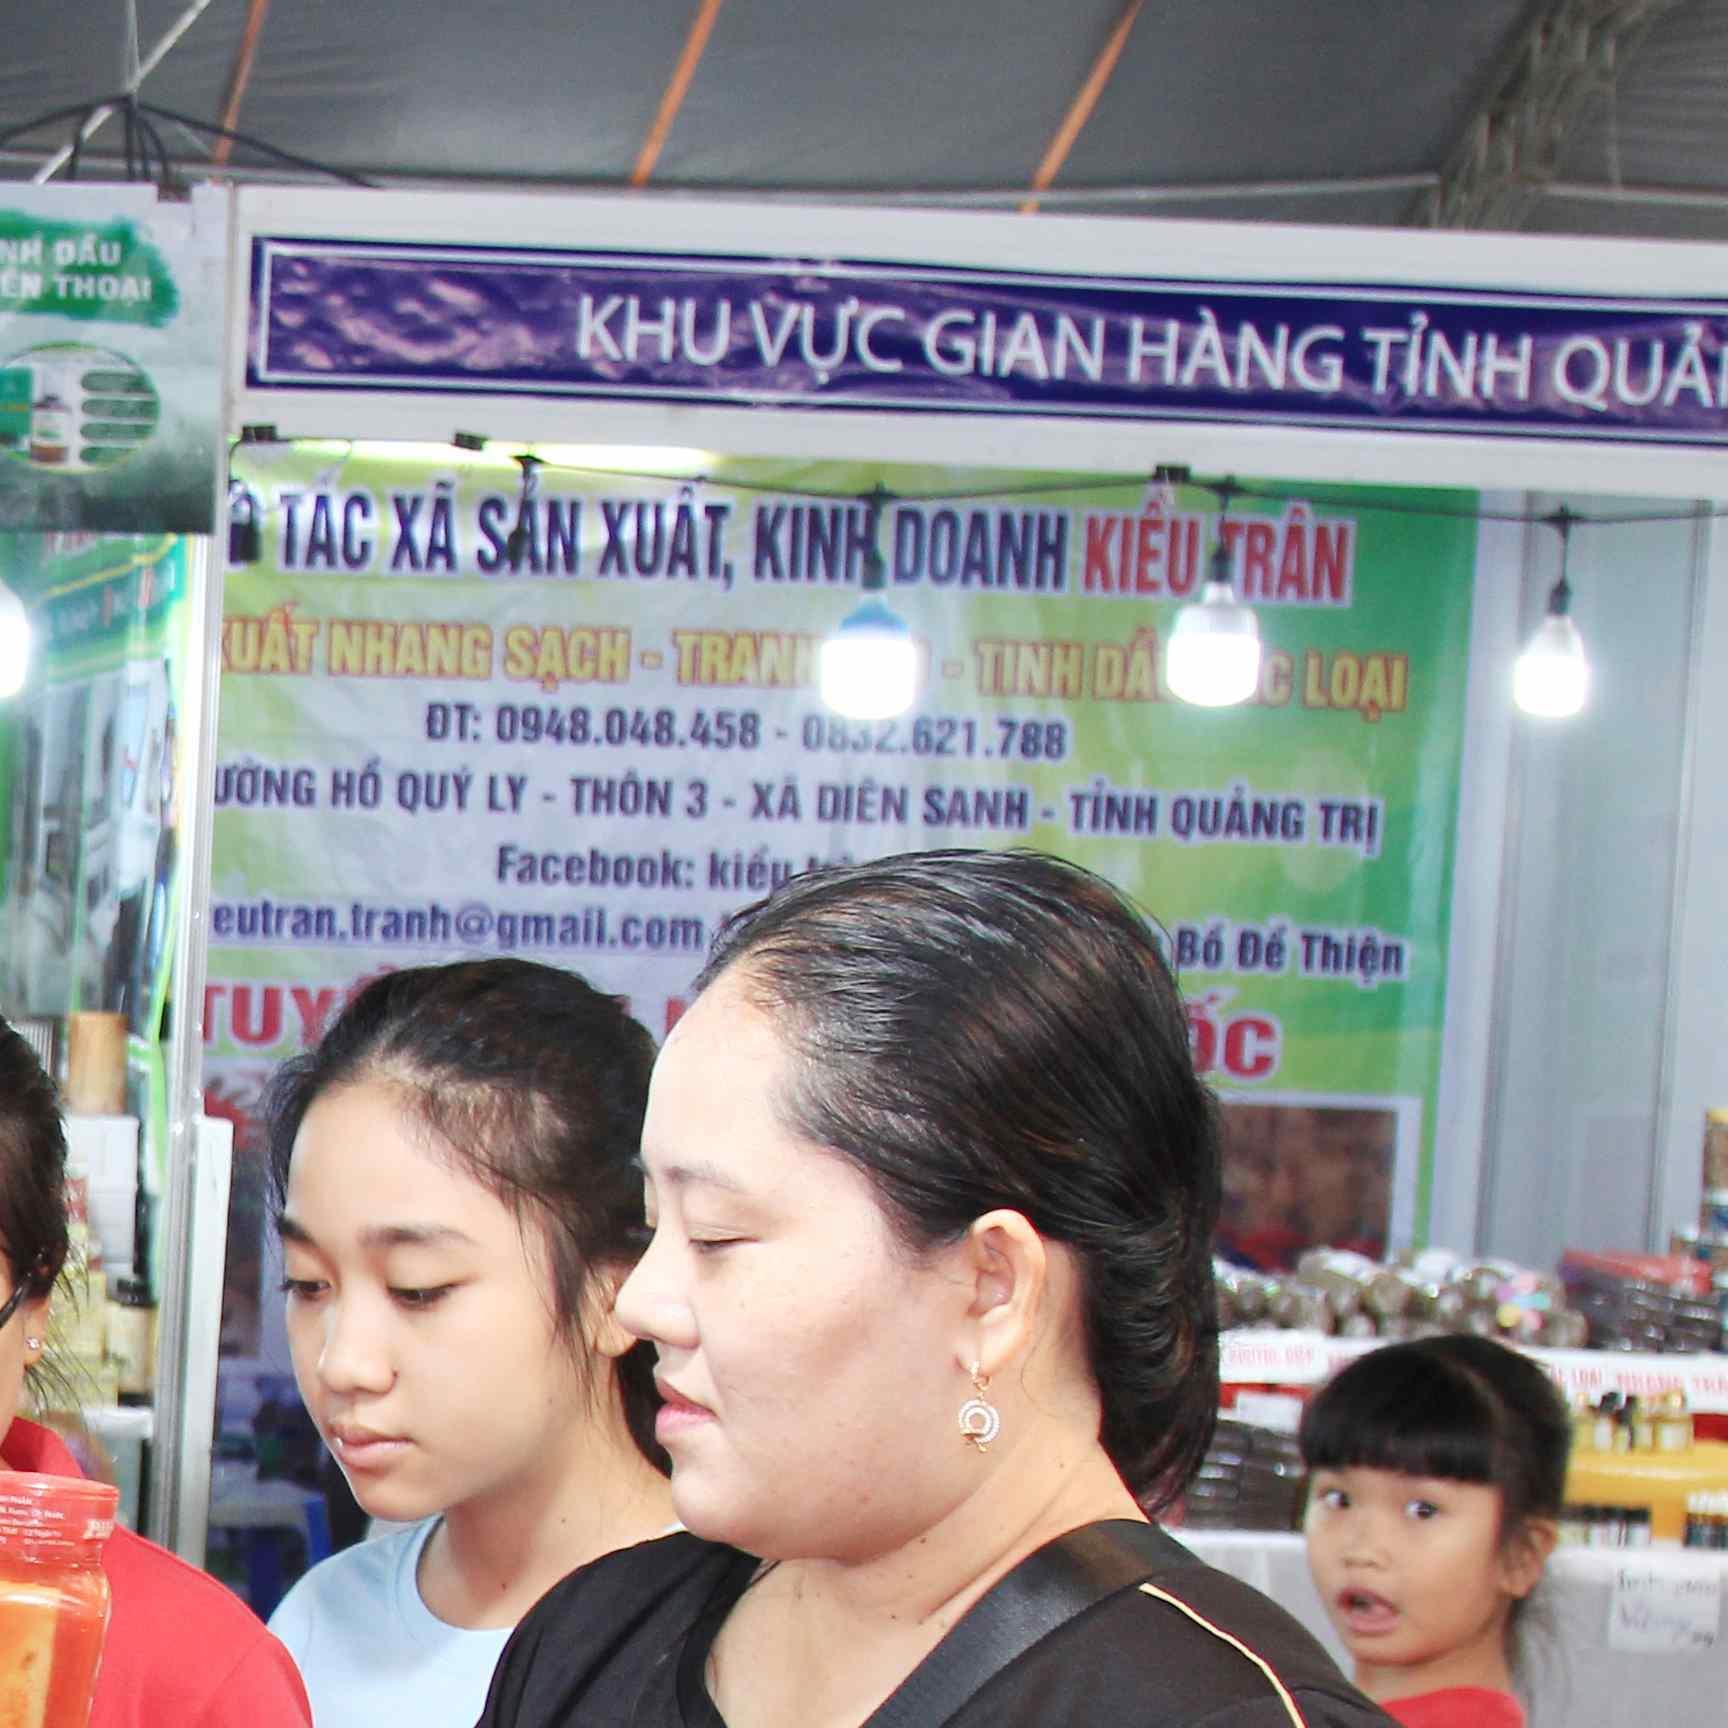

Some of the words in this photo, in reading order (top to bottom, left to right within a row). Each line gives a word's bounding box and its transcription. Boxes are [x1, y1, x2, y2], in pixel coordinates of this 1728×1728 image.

[52, 273, 152, 304] THOẠI
[577, 295, 731, 365] KHU
[748, 297, 905, 383] VỰC
[921, 312, 1104, 382] GIAN
[1128, 306, 1345, 393] HÀNG
[1363, 310, 1532, 400] TỈNH
[280, 470, 370, 568] TÁC
[390, 480, 458, 573] XÃ
[754, 500, 886, 583] KINH
[893, 507, 1068, 592] DOANH
[329, 622, 492, 682] NHANG
[505, 624, 631, 690] SẠCH
[977, 640, 1082, 698] TINH
[1305, 650, 1410, 721] LOẠI
[426, 702, 483, 743] ĐT:
[495, 704, 762, 749] 0948.048.458
[396, 764, 473, 815] QUÝ
[487, 776, 528, 813] LY
[571, 767, 673, 818] THÔN
[685, 780, 708, 819] 3
[750, 770, 804, 822] XÃ
[921, 788, 1029, 830] SANH
[1070, 777, 1158, 835] TỈNH
[1170, 782, 1304, 843] QUẢNG
[1318, 799, 1380, 848] TRỊ
[496, 844, 693, 889] Facebook:
[1301, 930, 1405, 983] Thiện
